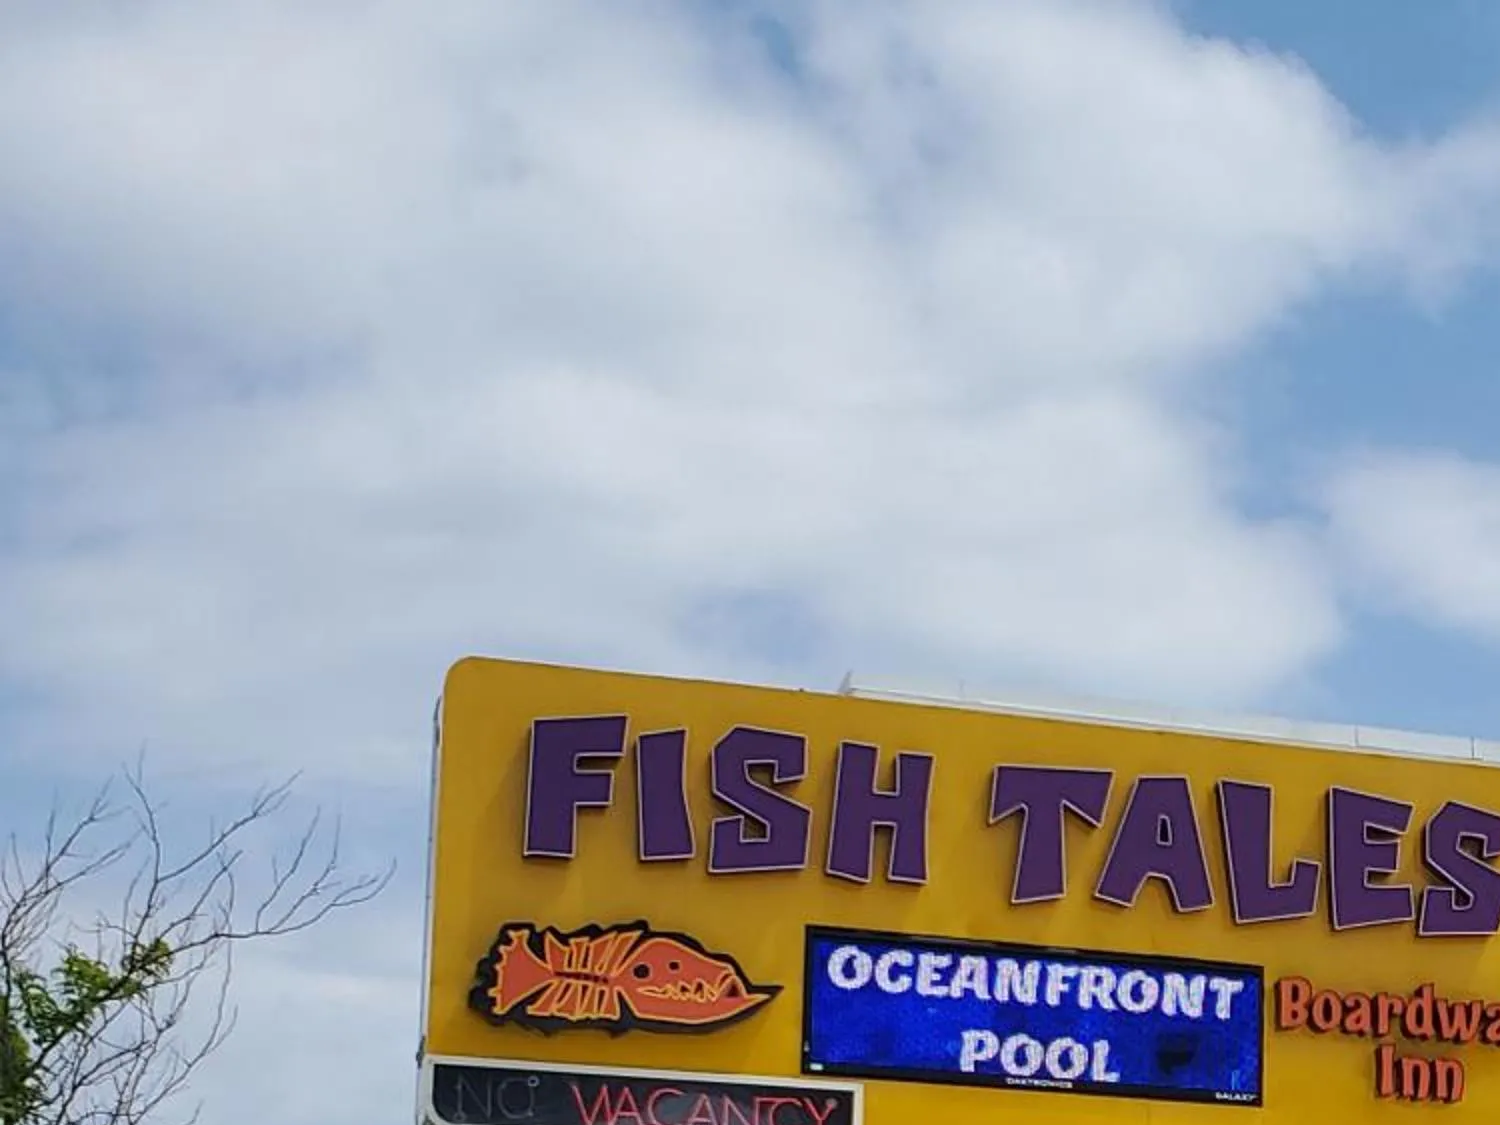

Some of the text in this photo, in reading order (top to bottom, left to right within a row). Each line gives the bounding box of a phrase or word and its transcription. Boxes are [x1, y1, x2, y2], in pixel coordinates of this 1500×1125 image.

[523, 714, 935, 885] FISH
[827, 944, 1245, 1020] OCEANFRONT
[957, 1029, 1121, 1084] POOL
[1375, 1042, 1465, 1104] Inn
